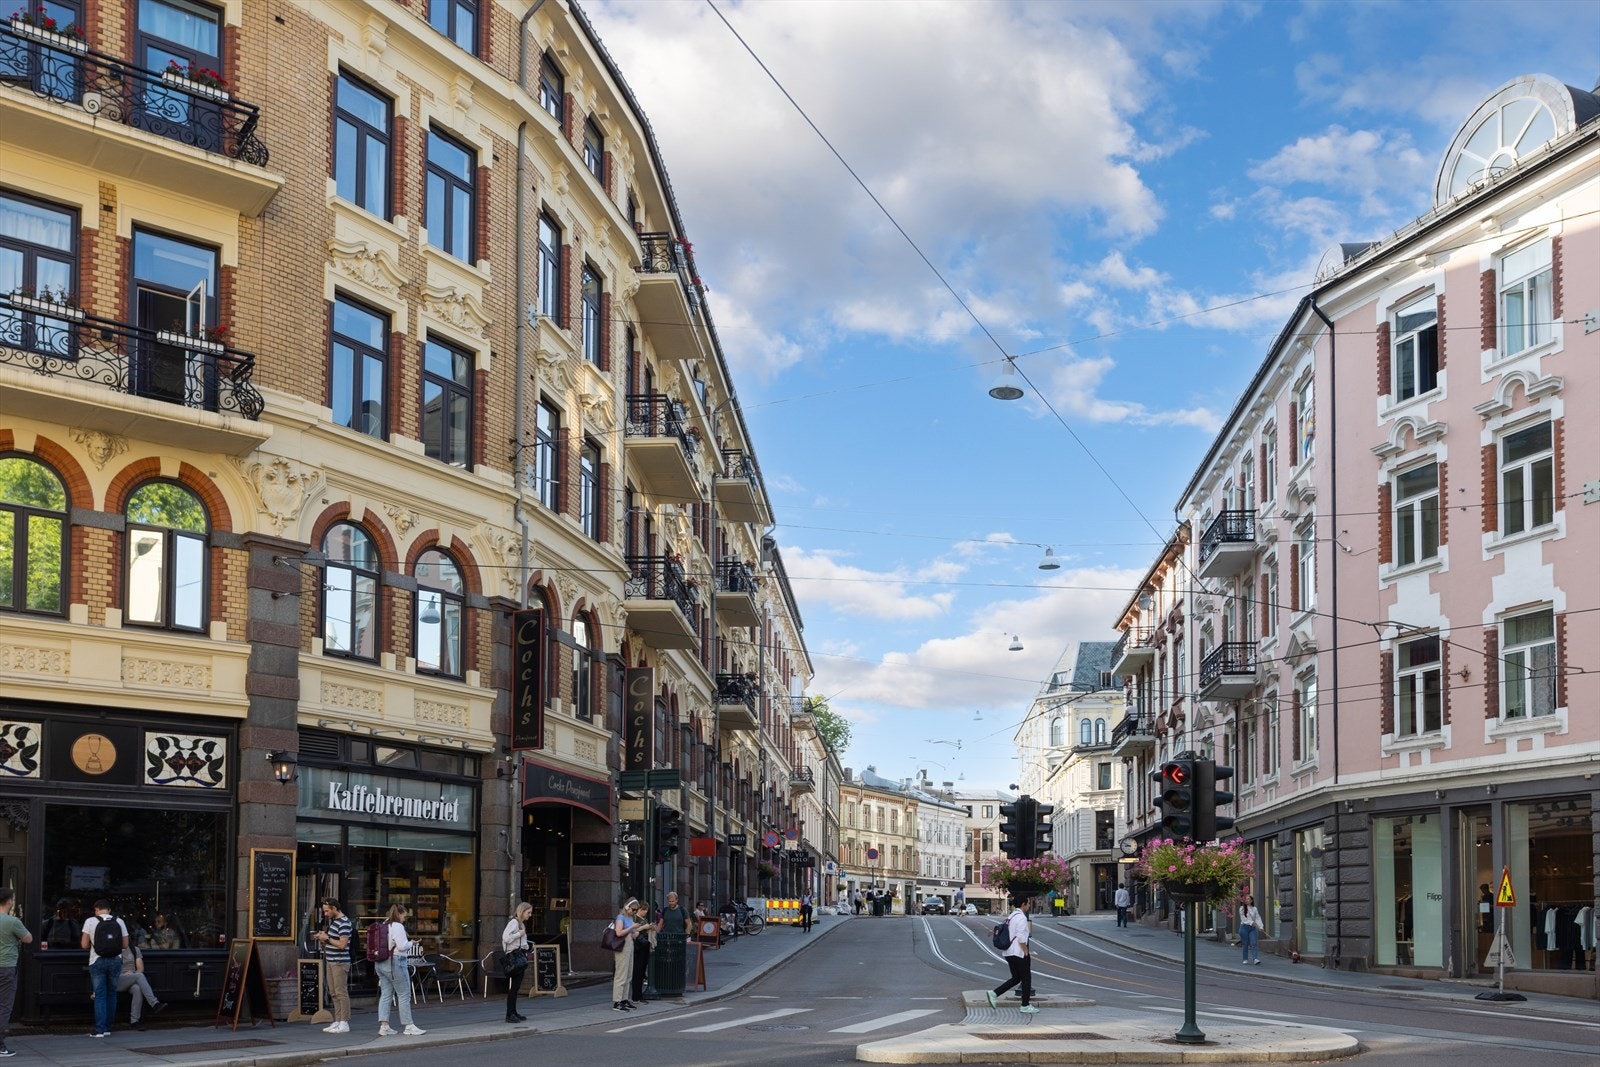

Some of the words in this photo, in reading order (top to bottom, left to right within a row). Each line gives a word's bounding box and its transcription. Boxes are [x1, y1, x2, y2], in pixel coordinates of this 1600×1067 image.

[517, 619, 538, 725] Cochs
[629, 676, 649, 763] Cochs
[328, 781, 459, 822] Kaffebrenneriet
